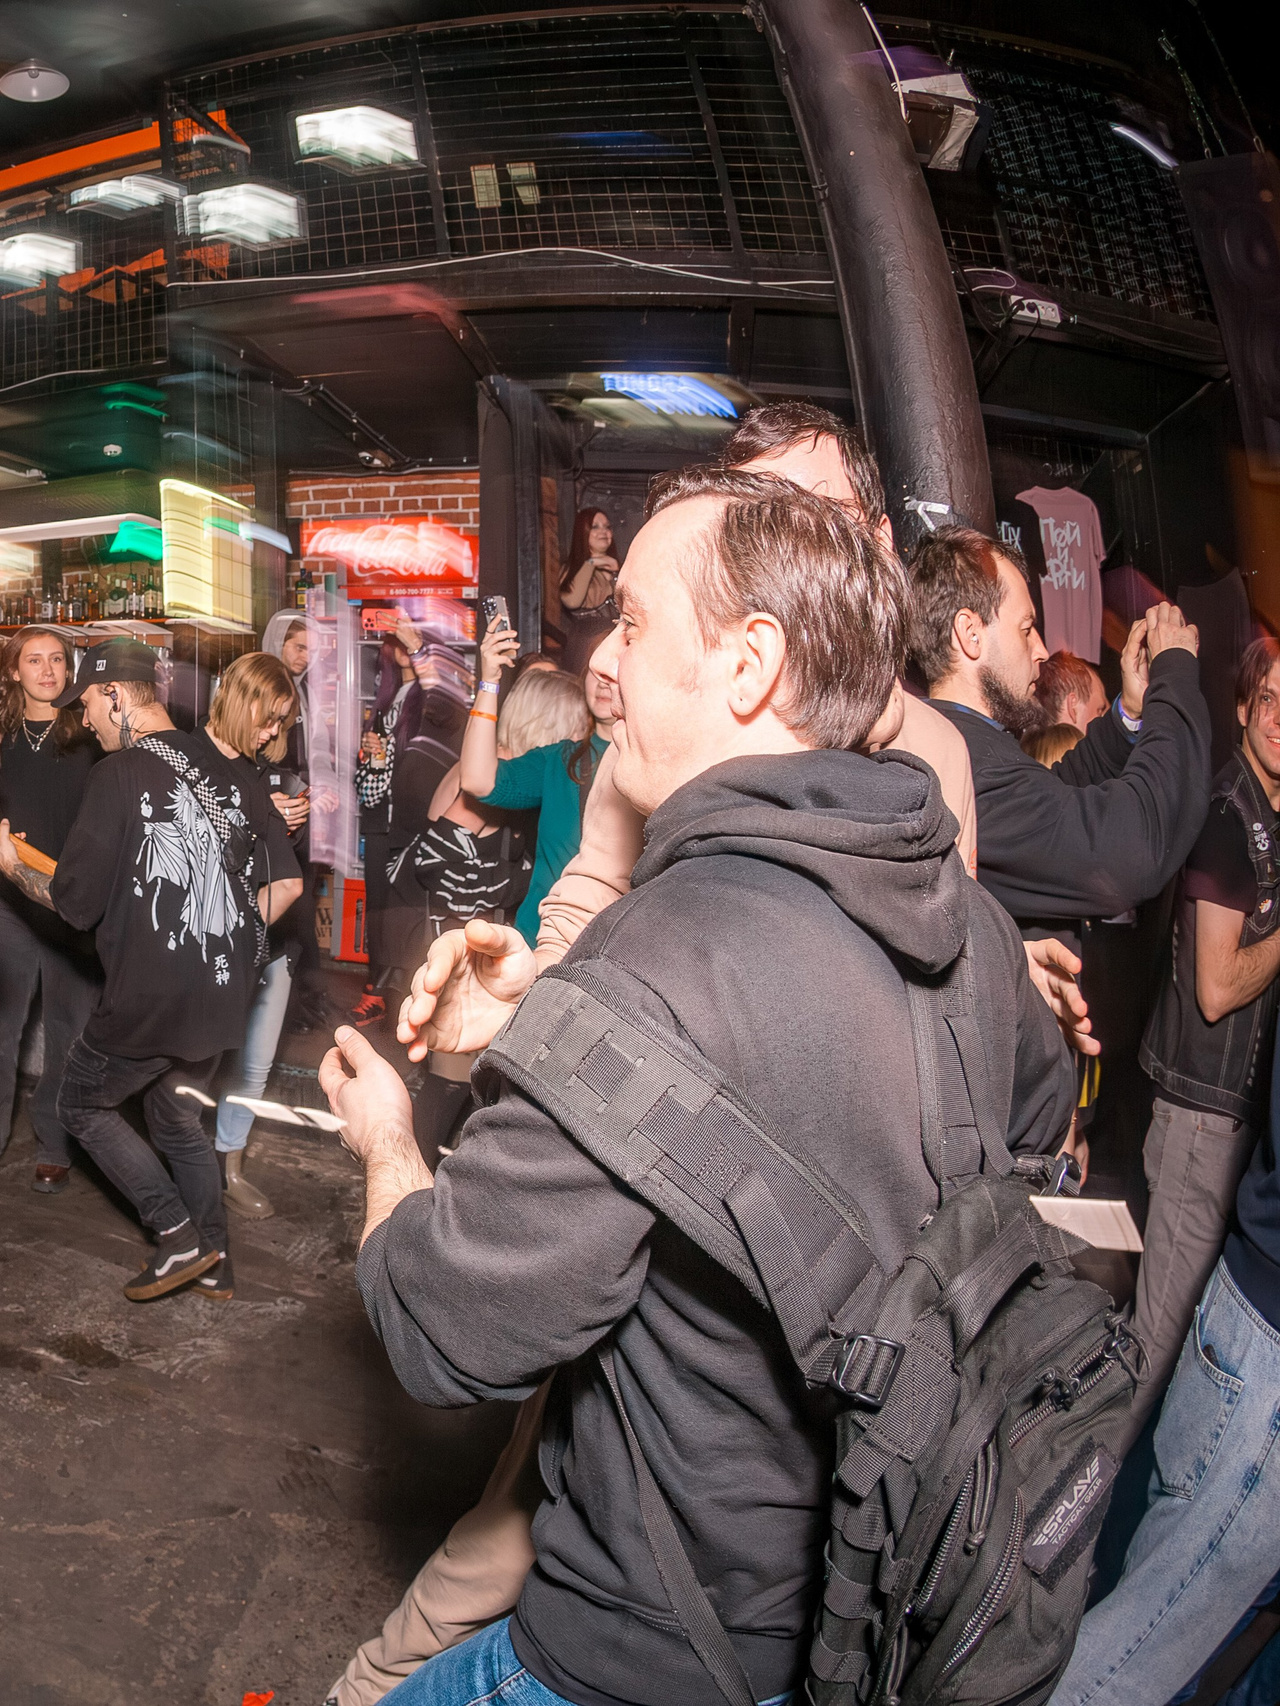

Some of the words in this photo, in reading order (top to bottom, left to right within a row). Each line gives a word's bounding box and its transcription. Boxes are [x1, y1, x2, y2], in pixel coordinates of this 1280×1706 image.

[214, 954, 230, 986] 死神
[1041, 1466, 1093, 1539] SPLAV
[1051, 1505, 1086, 1545] TACTICAL
[1084, 1478, 1103, 1504] GEAR
